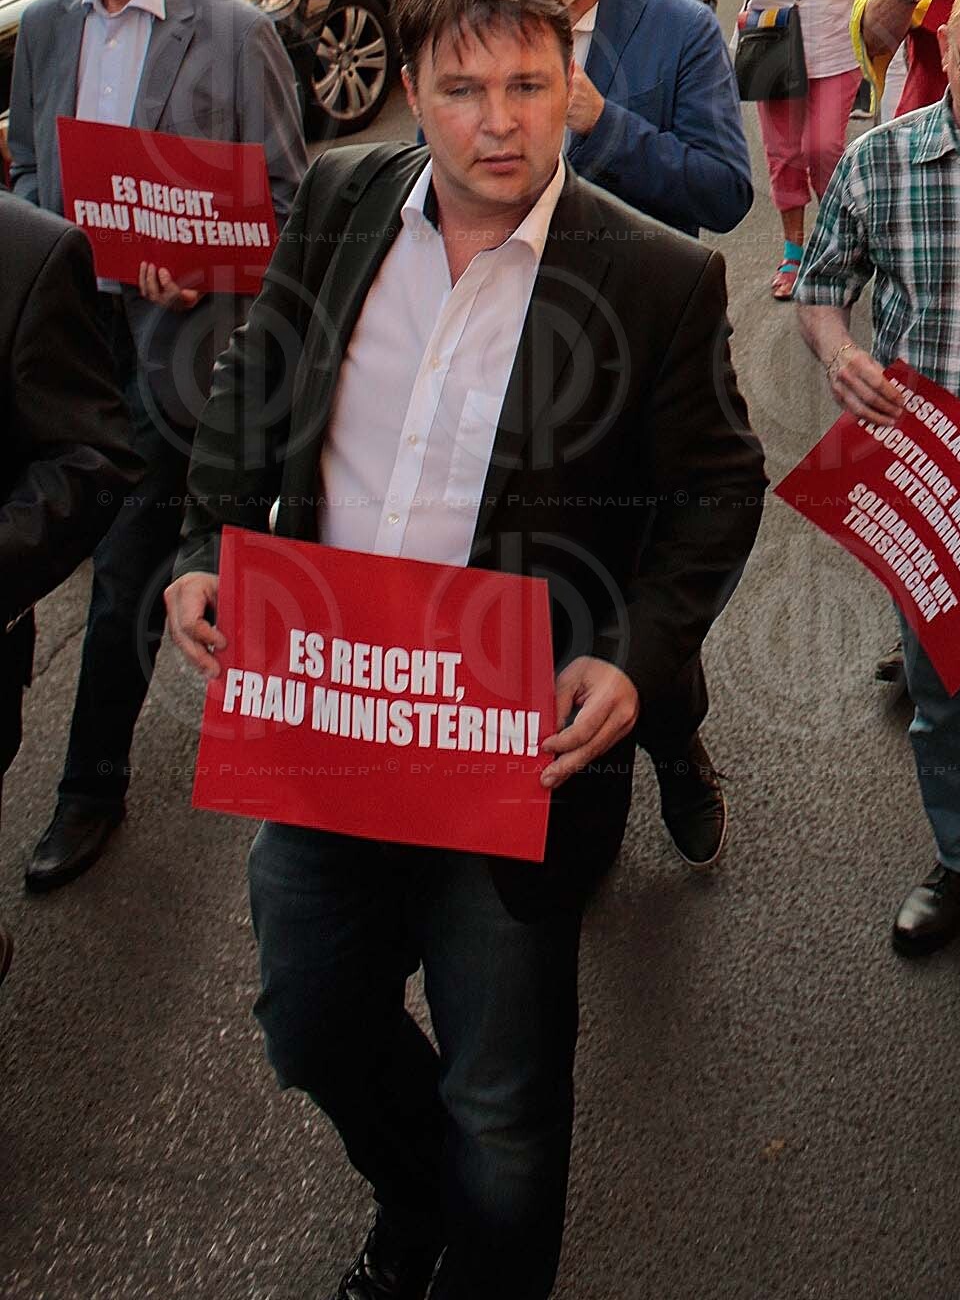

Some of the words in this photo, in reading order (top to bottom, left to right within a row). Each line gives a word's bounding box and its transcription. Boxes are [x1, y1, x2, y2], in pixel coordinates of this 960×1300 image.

[74, 199, 130, 231] FRAU
[132, 207, 270, 247] MINISTERIN!
[111, 174, 138, 204] ES
[140, 180, 219, 220] REICHT,
[842, 507, 941, 623] TRAISKIRCHEN
[847, 482, 939, 580] SOLIDARITÄT
[929, 573, 959, 614] MIT
[290, 628, 325, 679] ES
[331, 638, 465, 702] REICHT,
[222, 668, 306, 726] FRAU
[312, 686, 540, 757] MINISTERIN!
